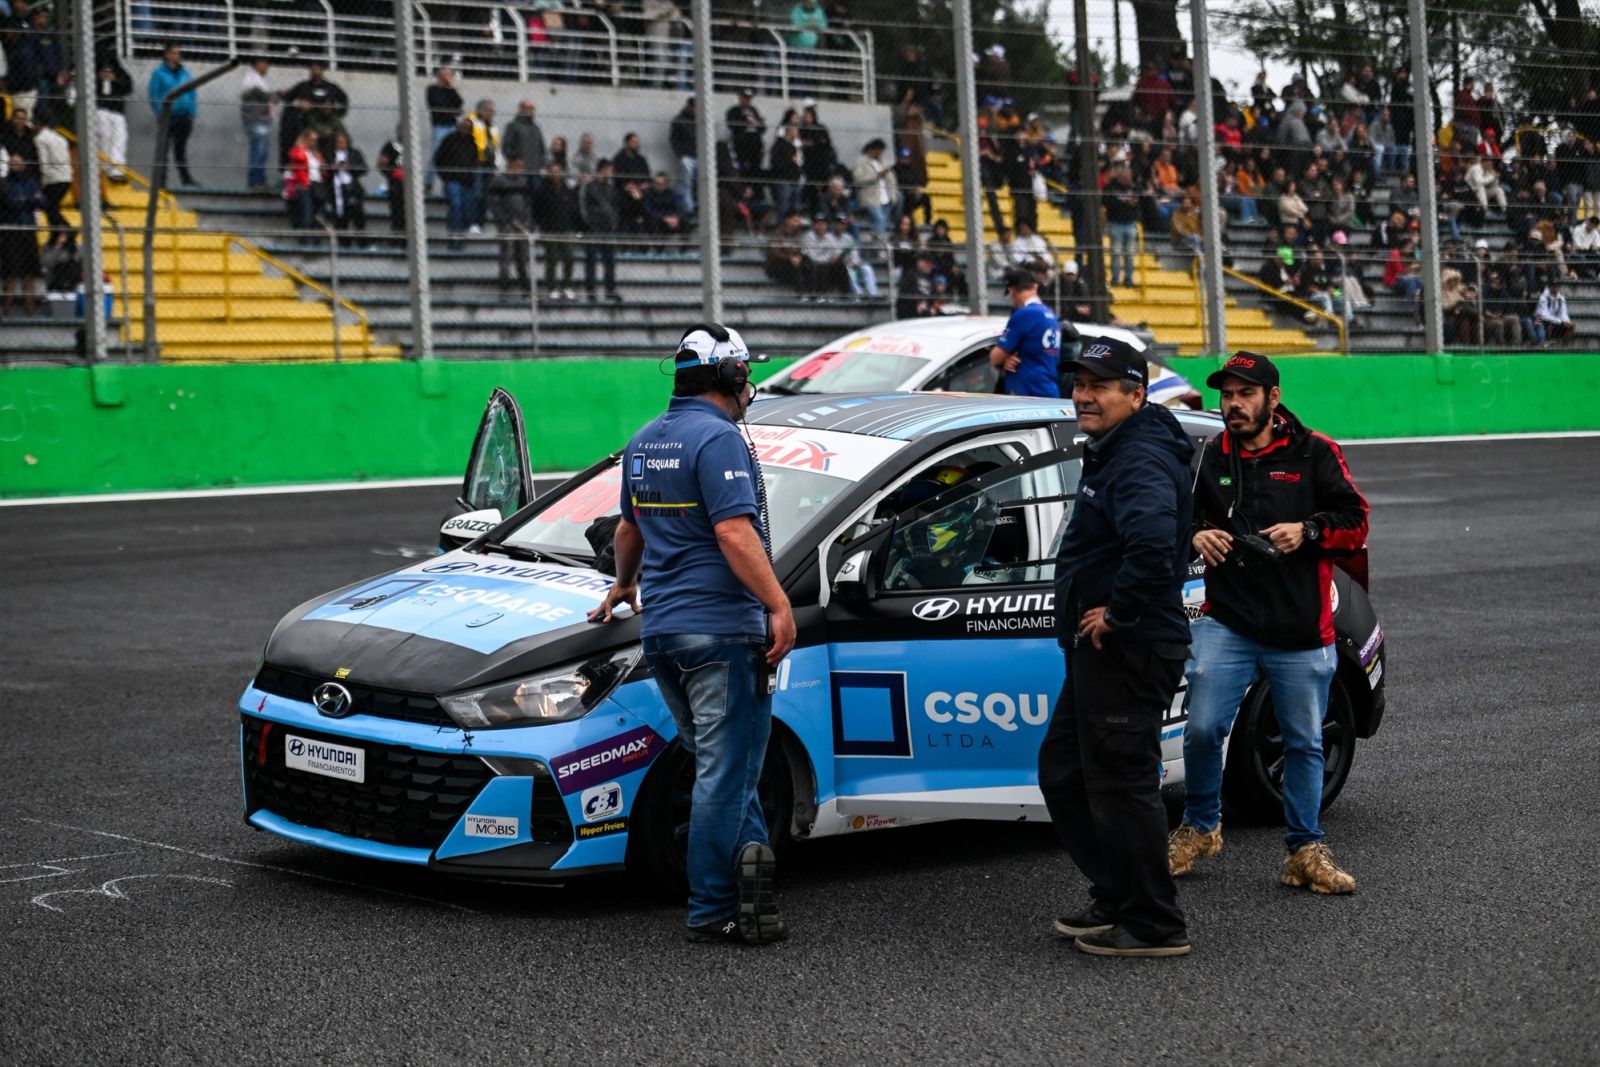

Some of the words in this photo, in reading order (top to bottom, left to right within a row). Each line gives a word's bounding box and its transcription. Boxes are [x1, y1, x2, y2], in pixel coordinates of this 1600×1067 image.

[646, 458, 680, 471] CSQUARE
[757, 440, 838, 472] LIX
[473, 564, 616, 592] HYUNDA
[417, 584, 574, 622] CSQUARE
[965, 593, 1055, 615] HYUND
[966, 616, 1056, 632] FINANCIAME
[923, 691, 1049, 732] CSQU
[927, 733, 994, 749] LTDA
[308, 744, 357, 766] HYUNDAI
[558, 737, 648, 779] SPEEDMAX
[622, 748, 649, 763] PNEUS
[308, 760, 357, 777] FINANCIAMENTOS
[467, 816, 497, 824] HYUNDAI
[476, 824, 516, 836] MOBIS
[580, 826, 603, 836] Hipper
[604, 822, 625, 831] Freios
